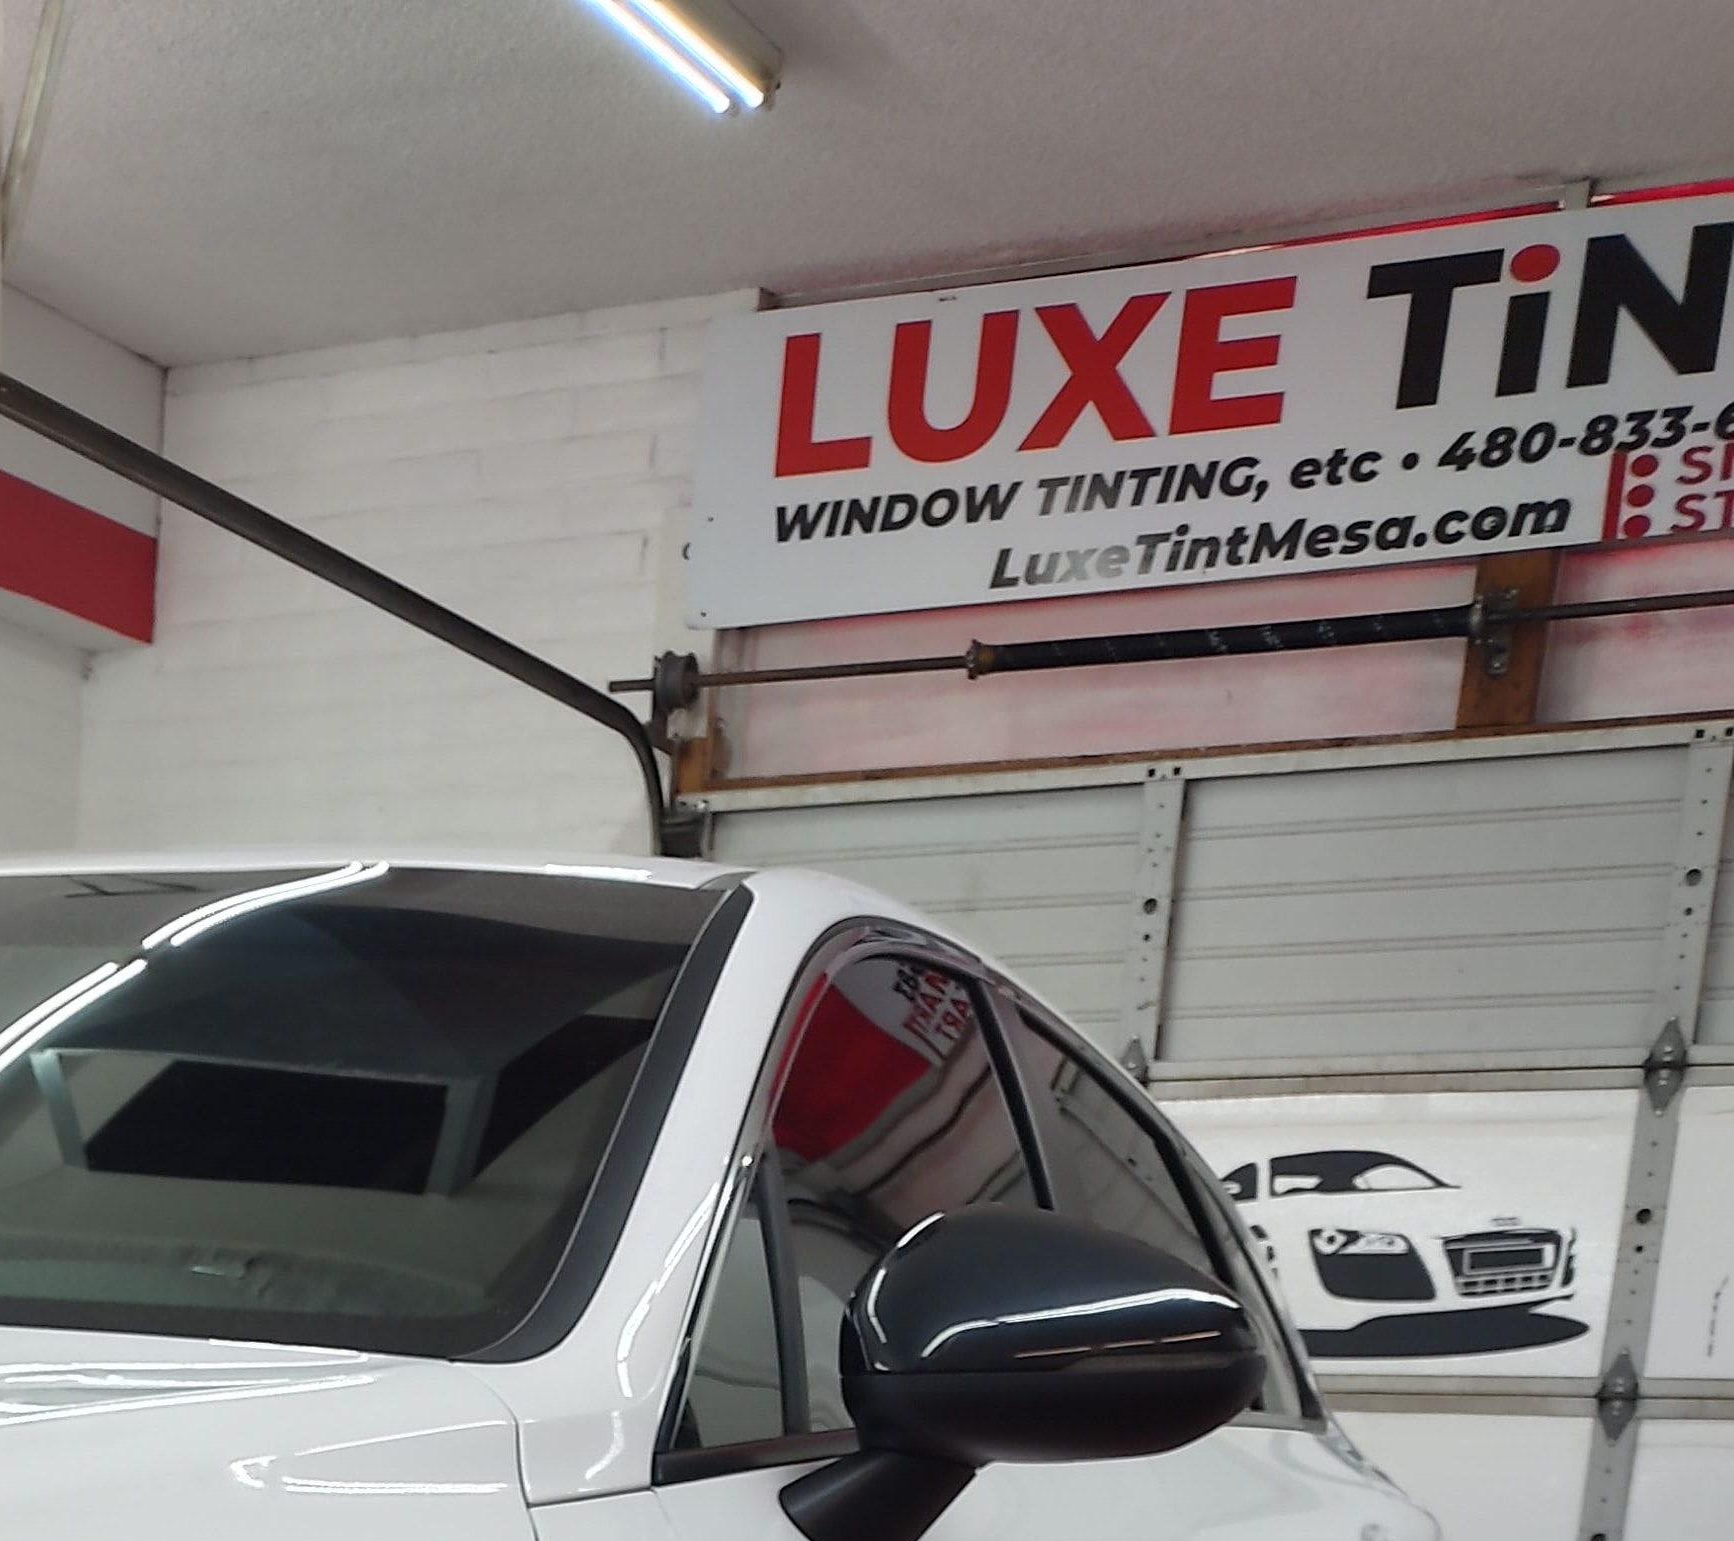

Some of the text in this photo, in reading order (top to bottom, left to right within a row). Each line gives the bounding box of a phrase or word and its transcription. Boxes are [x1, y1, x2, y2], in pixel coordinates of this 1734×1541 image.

[774, 275, 1298, 478] LUXE
[774, 480, 1023, 544] WINDOW
[1037, 455, 1269, 518] TINTING,
[1289, 448, 1383, 490] etc
[988, 498, 1572, 590] LuxeTintMesa.com
